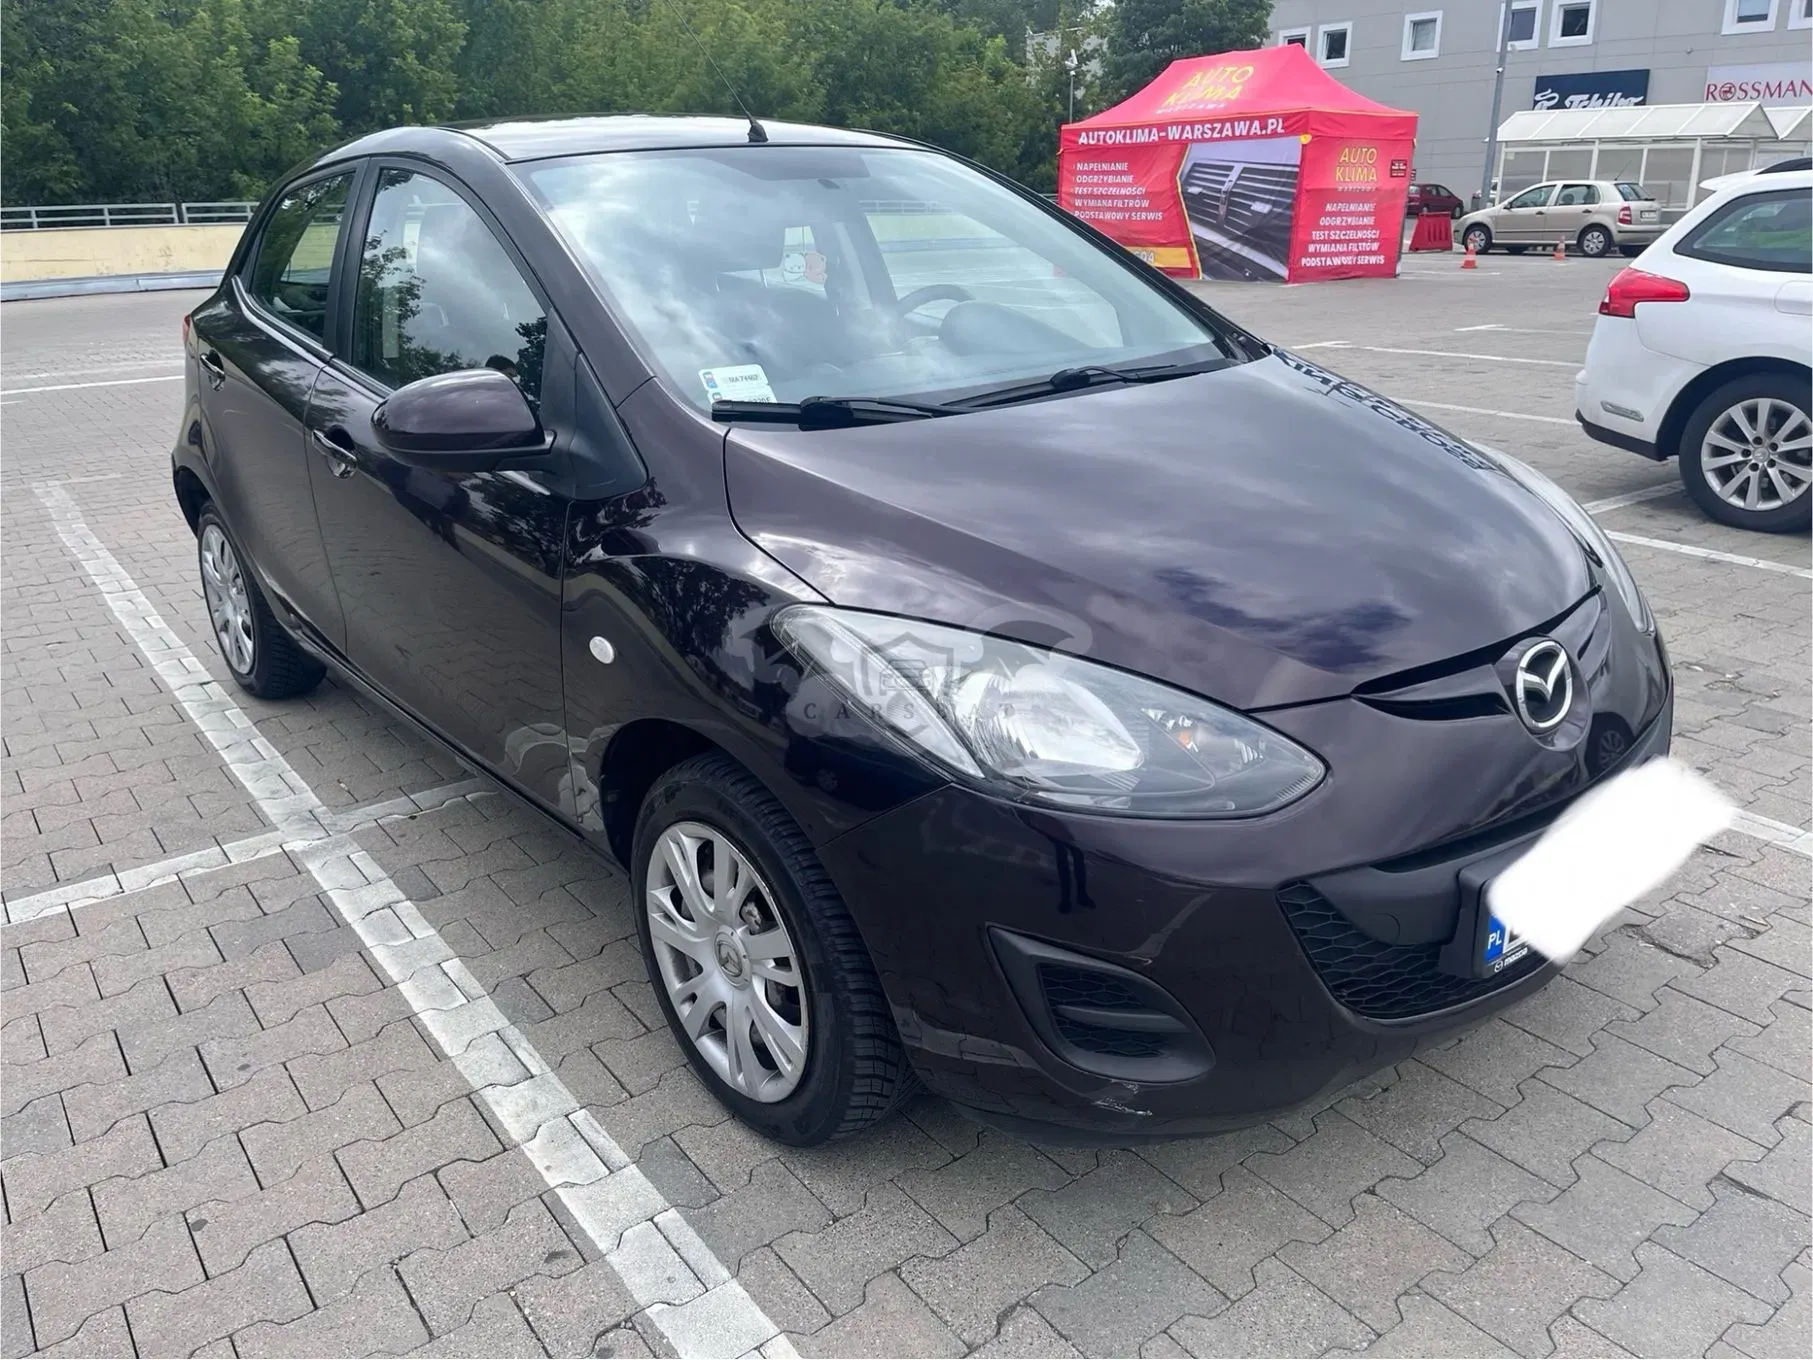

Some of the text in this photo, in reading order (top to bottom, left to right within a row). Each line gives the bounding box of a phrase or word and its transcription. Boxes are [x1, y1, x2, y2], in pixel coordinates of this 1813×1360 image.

[1182, 65, 1255, 89] AUTO
[1162, 85, 1243, 108] KLIMA
[1078, 118, 1285, 146] AUTOKLIMA-WARSZAWA.PL
[1339, 147, 1378, 164] AUTO
[1335, 166, 1378, 182] KLIMA
[1074, 187, 1093, 195] TEST
[1131, 212, 1163, 221] SERWIS
[1312, 230, 1329, 240] TEST
[1356, 254, 1385, 265] SERWIS
[1487, 929, 1502, 950] PL
